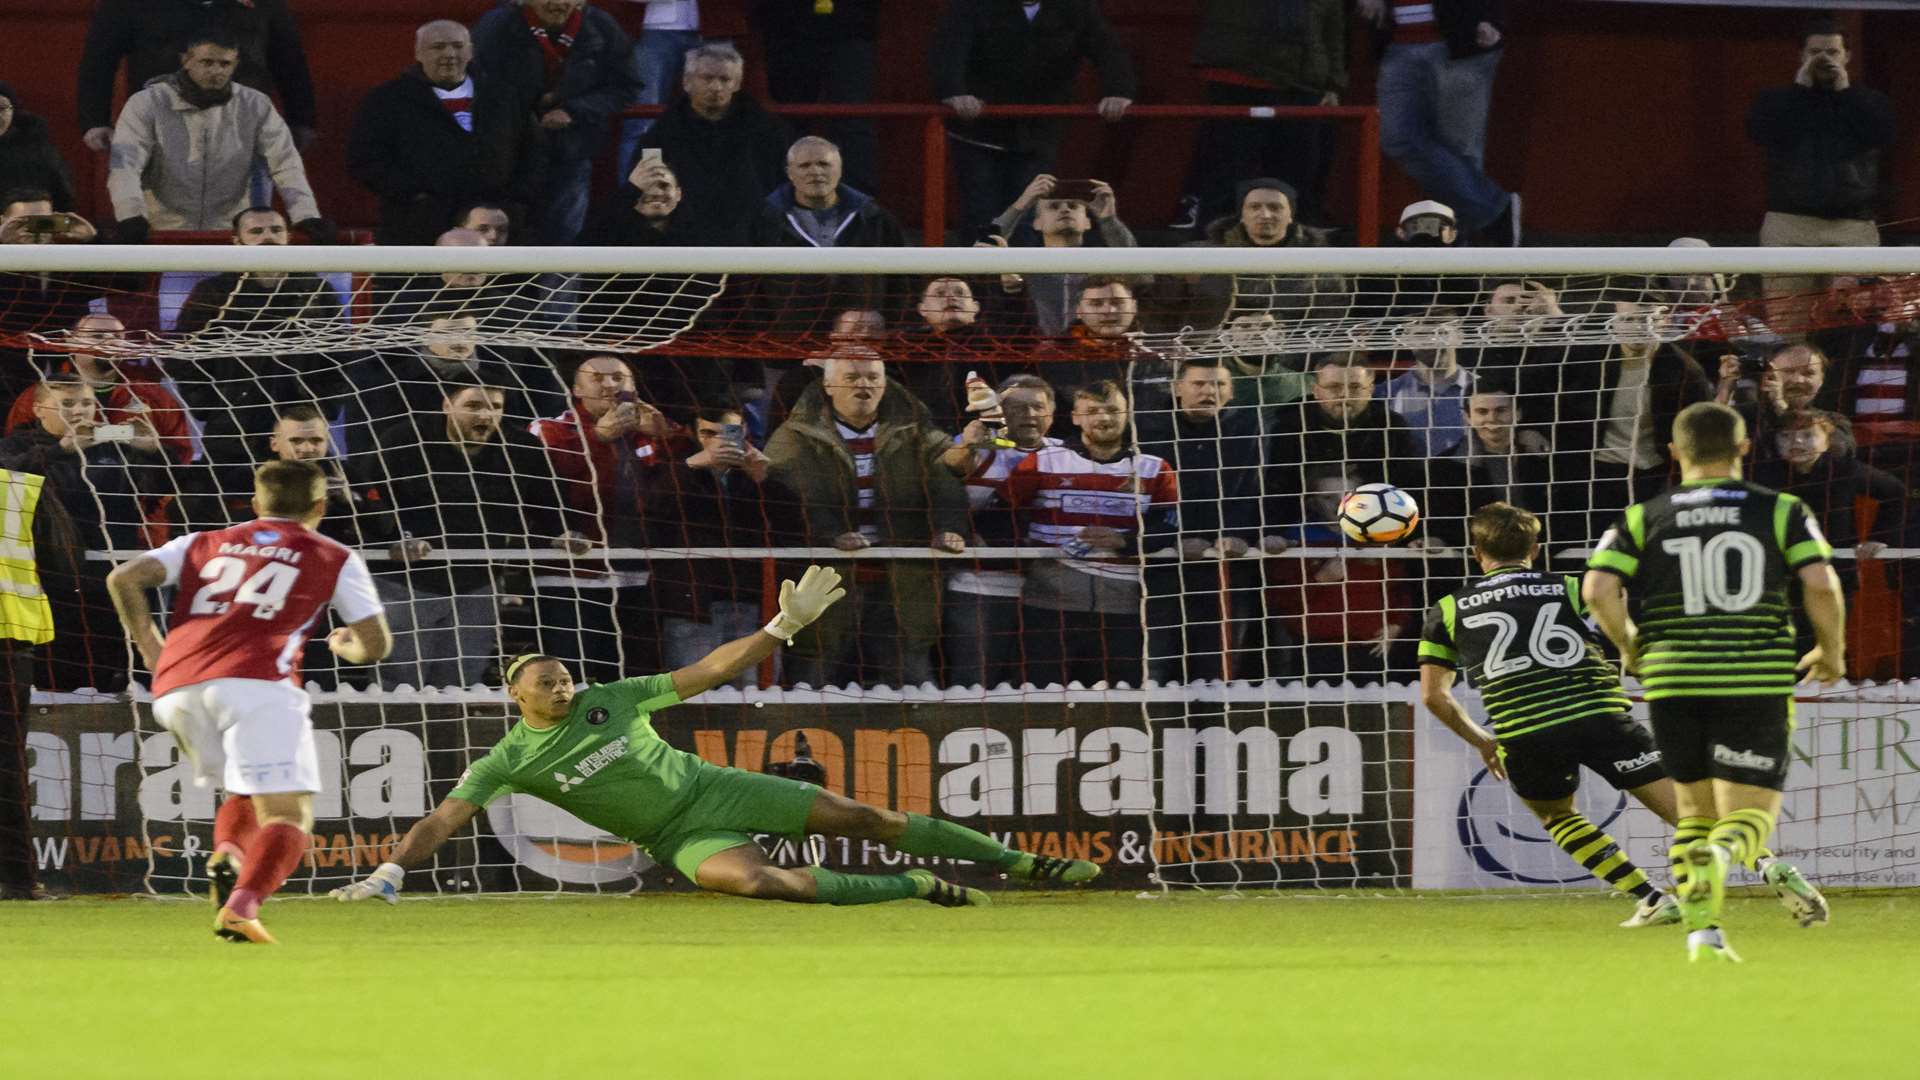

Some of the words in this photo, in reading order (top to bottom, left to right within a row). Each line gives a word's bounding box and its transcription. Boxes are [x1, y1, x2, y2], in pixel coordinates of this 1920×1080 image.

[1676, 506, 1741, 528] ROWE
[218, 542, 302, 564] MAGRI
[190, 556, 300, 620] 24
[1661, 531, 1767, 615] 10
[1457, 583, 1565, 610] COPPINGER
[1462, 602, 1585, 680] 26
[573, 735, 629, 771] MITSUBISHI
[581, 745, 629, 777] ELECTRIC
[1017, 831, 1112, 864] VANS
[1117, 831, 1145, 864] &
[1153, 831, 1360, 864] INSURANCE
[1816, 842, 1877, 862] security
[1884, 842, 1916, 858] and
[1826, 871, 1879, 891] please
[1883, 870, 1917, 887] visit
